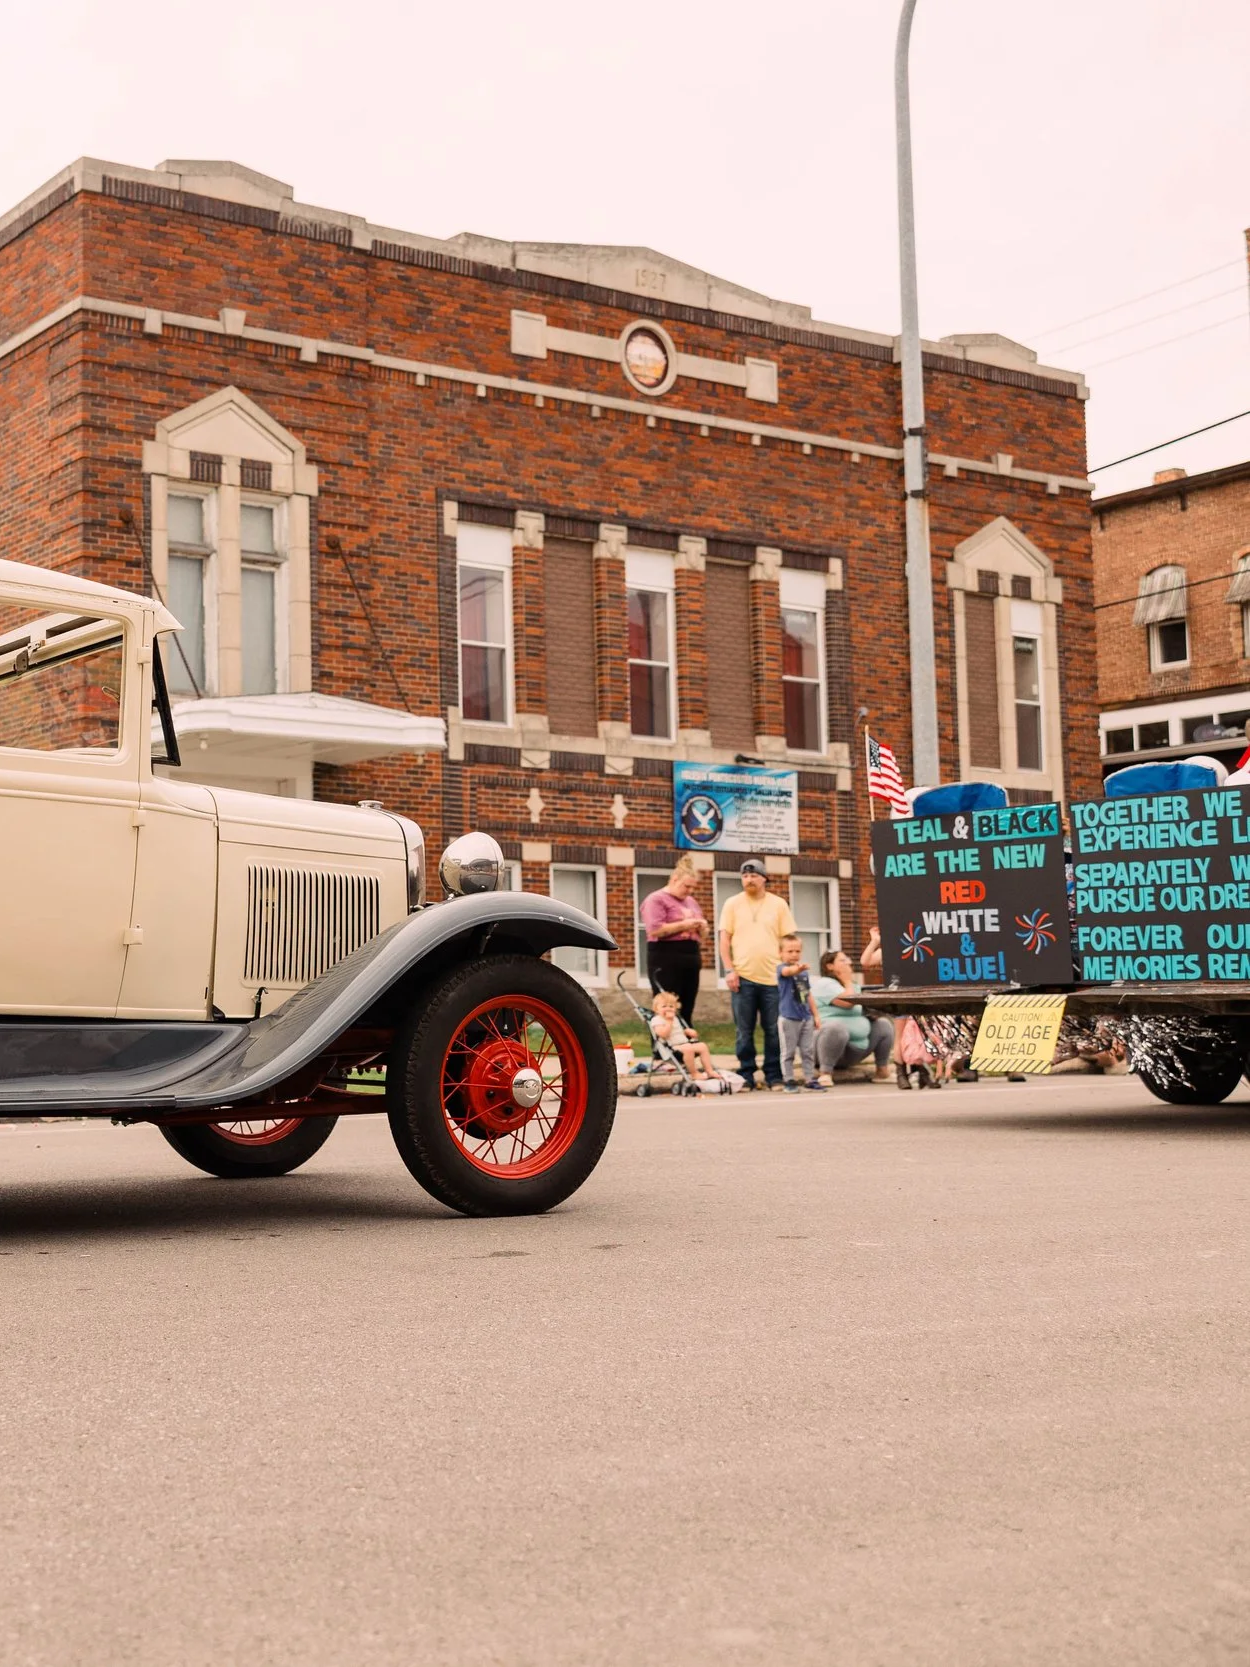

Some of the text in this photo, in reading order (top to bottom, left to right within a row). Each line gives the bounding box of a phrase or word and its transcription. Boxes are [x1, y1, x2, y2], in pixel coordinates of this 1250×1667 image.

[1070, 791, 1243, 828] TOGETHER WE
[893, 809, 1055, 845] TEAL & BLACK
[1078, 817, 1250, 853] EXPERIENCE L
[884, 843, 1045, 877] ARE THE NEW
[1075, 857, 1210, 889] SEPARATELY
[940, 880, 986, 904] RED
[1076, 883, 1250, 914] PURSUE OUR DRE
[922, 908, 1000, 934] WHITE
[960, 933, 977, 956] &
[1078, 924, 1184, 951] FOREVER
[938, 951, 1007, 981] BLUE!
[1083, 954, 1202, 980] MEMORIES
[1001, 1012, 1043, 1022] CAUTION!
[985, 1024, 1053, 1040] OLD AGE
[991, 1042, 1037, 1056] AHEAD
